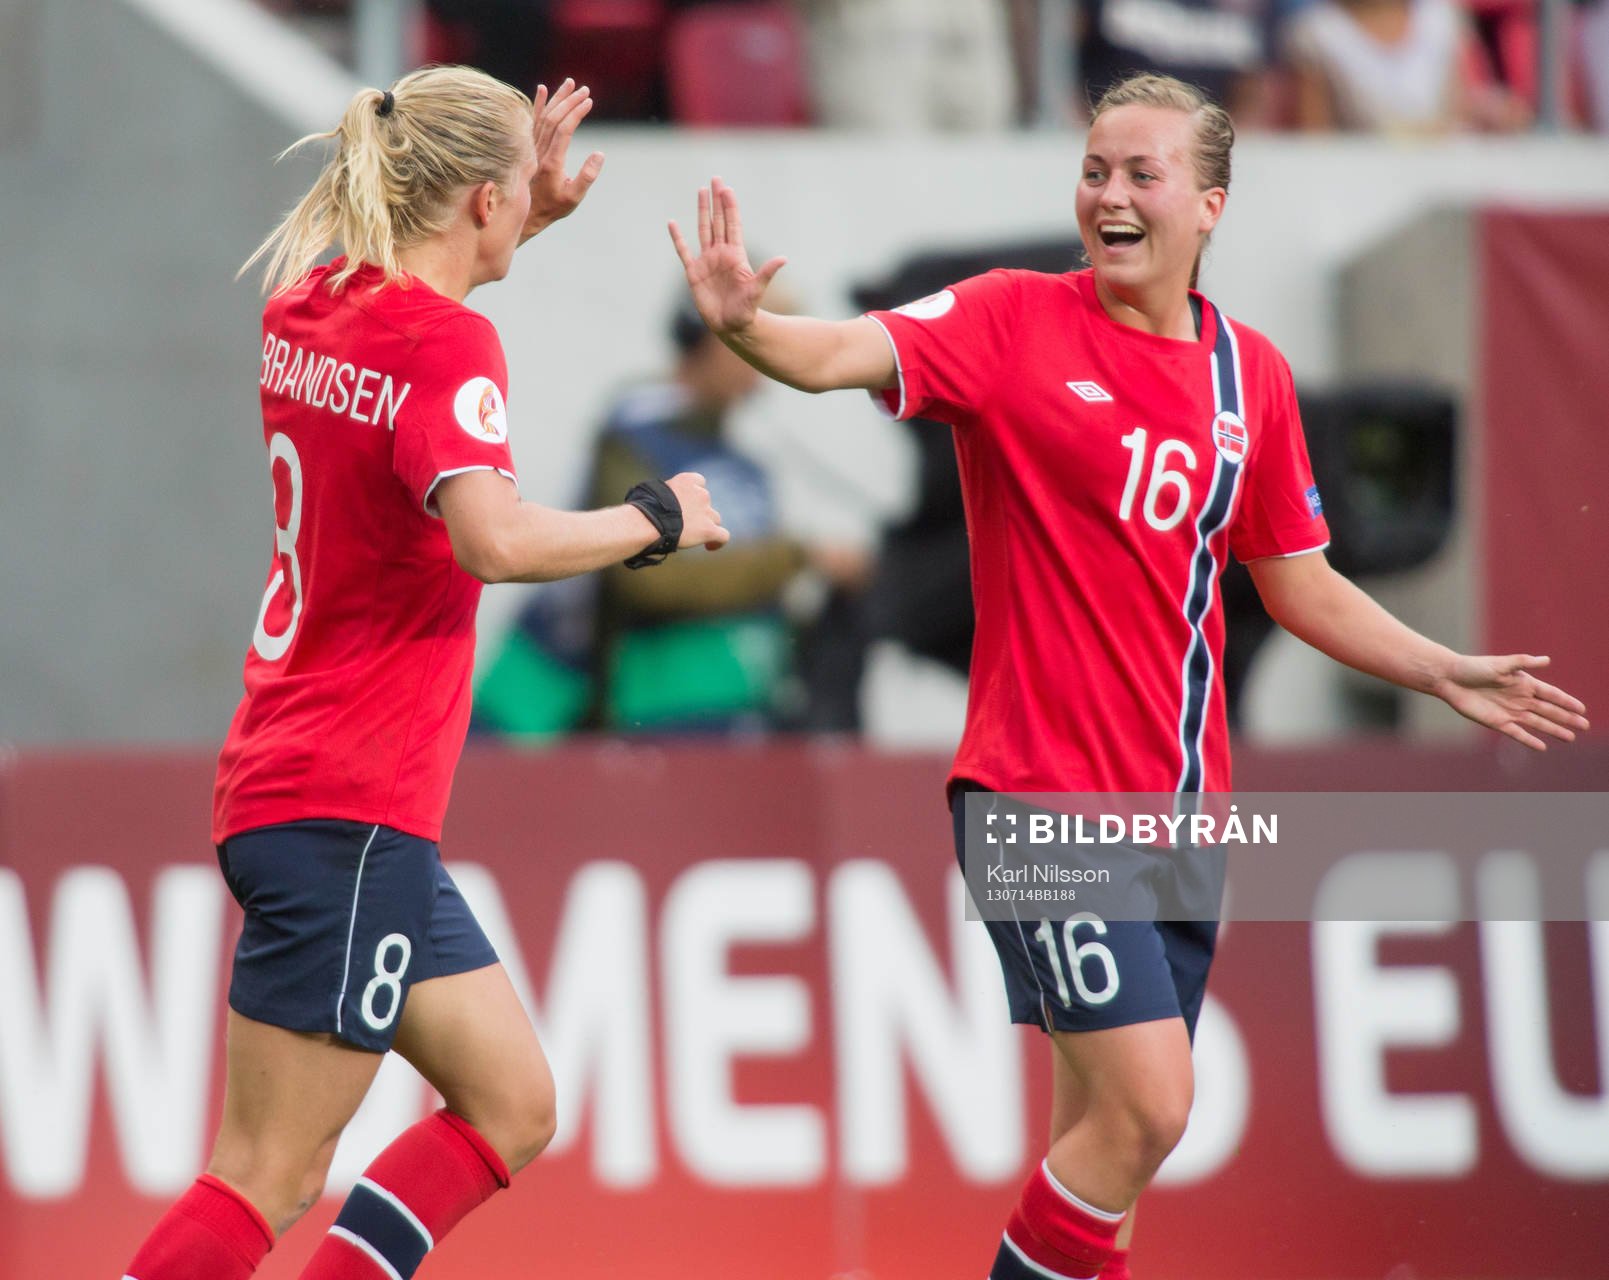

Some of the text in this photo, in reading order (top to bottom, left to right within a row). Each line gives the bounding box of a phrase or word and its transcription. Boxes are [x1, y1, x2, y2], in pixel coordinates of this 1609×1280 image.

[1119, 427, 1198, 532] 16
[252, 432, 303, 661] 8
[361, 933, 411, 1031] 8
[1035, 911, 1120, 1008] 16
[0, 851, 1609, 1198] WMEN EU
